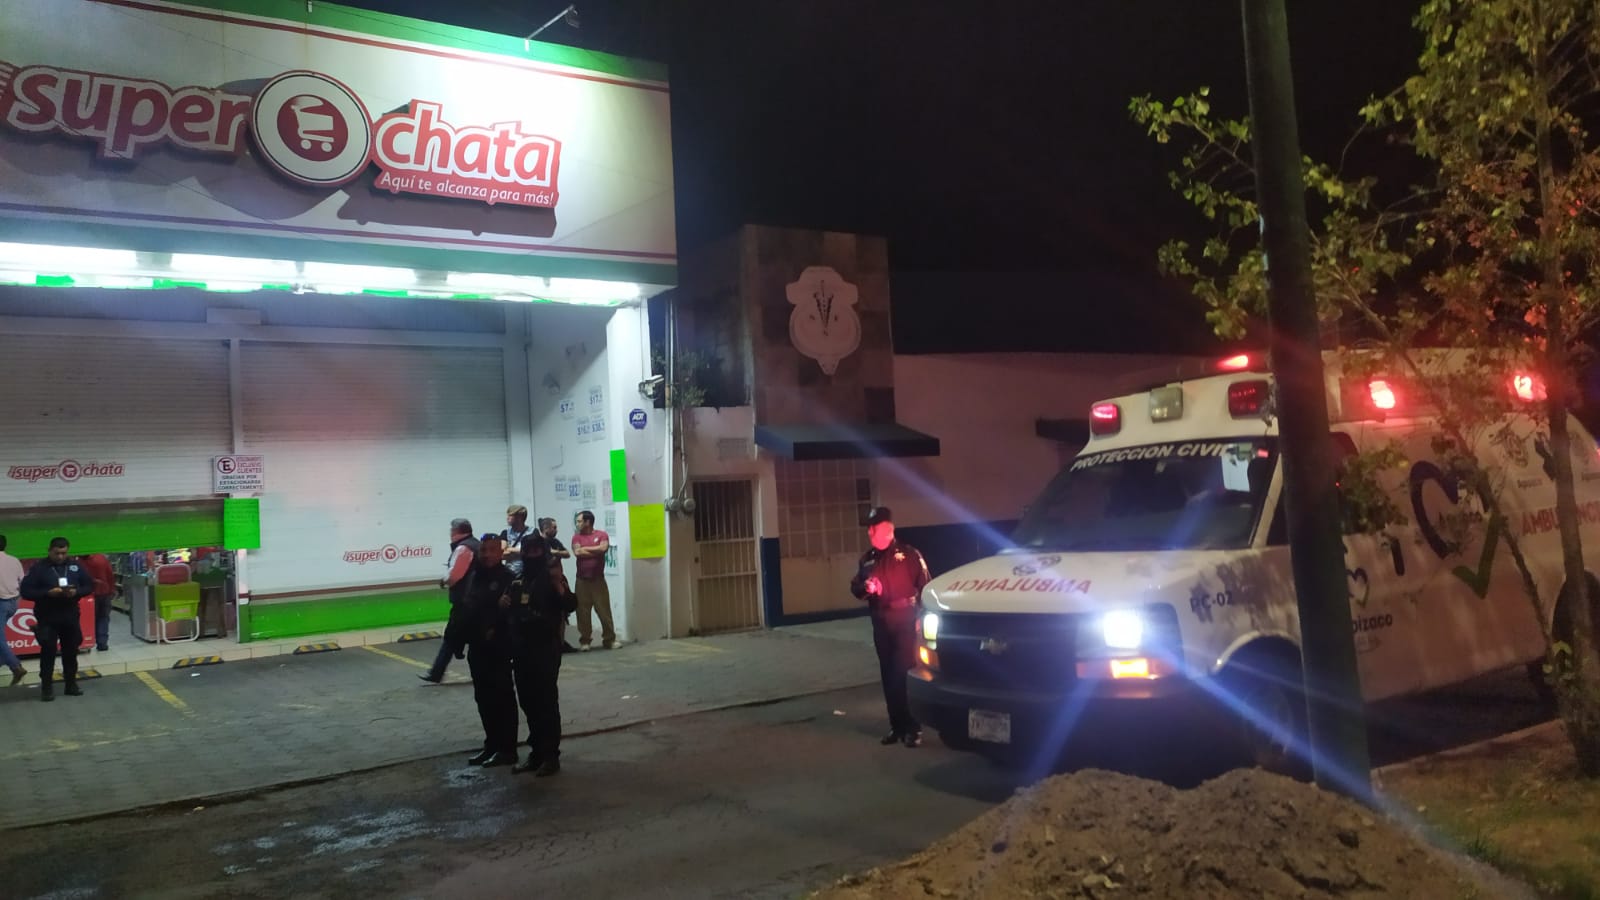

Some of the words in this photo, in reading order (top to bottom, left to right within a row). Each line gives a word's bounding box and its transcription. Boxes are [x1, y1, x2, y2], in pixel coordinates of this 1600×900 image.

[9, 67, 252, 158] super
[375, 102, 556, 188] chata
[380, 172, 415, 191] Aquí
[418, 178, 432, 191] te
[436, 181, 488, 197] alcanza
[489, 188, 520, 201] para
[523, 190, 554, 205] más!
[14, 466, 58, 481] super
[82, 463, 124, 476] chata
[1070, 446, 1173, 472] PROTECCION
[1177, 443, 1228, 457] CIVI
[348, 550, 380, 563] super
[400, 546, 432, 557] chata
